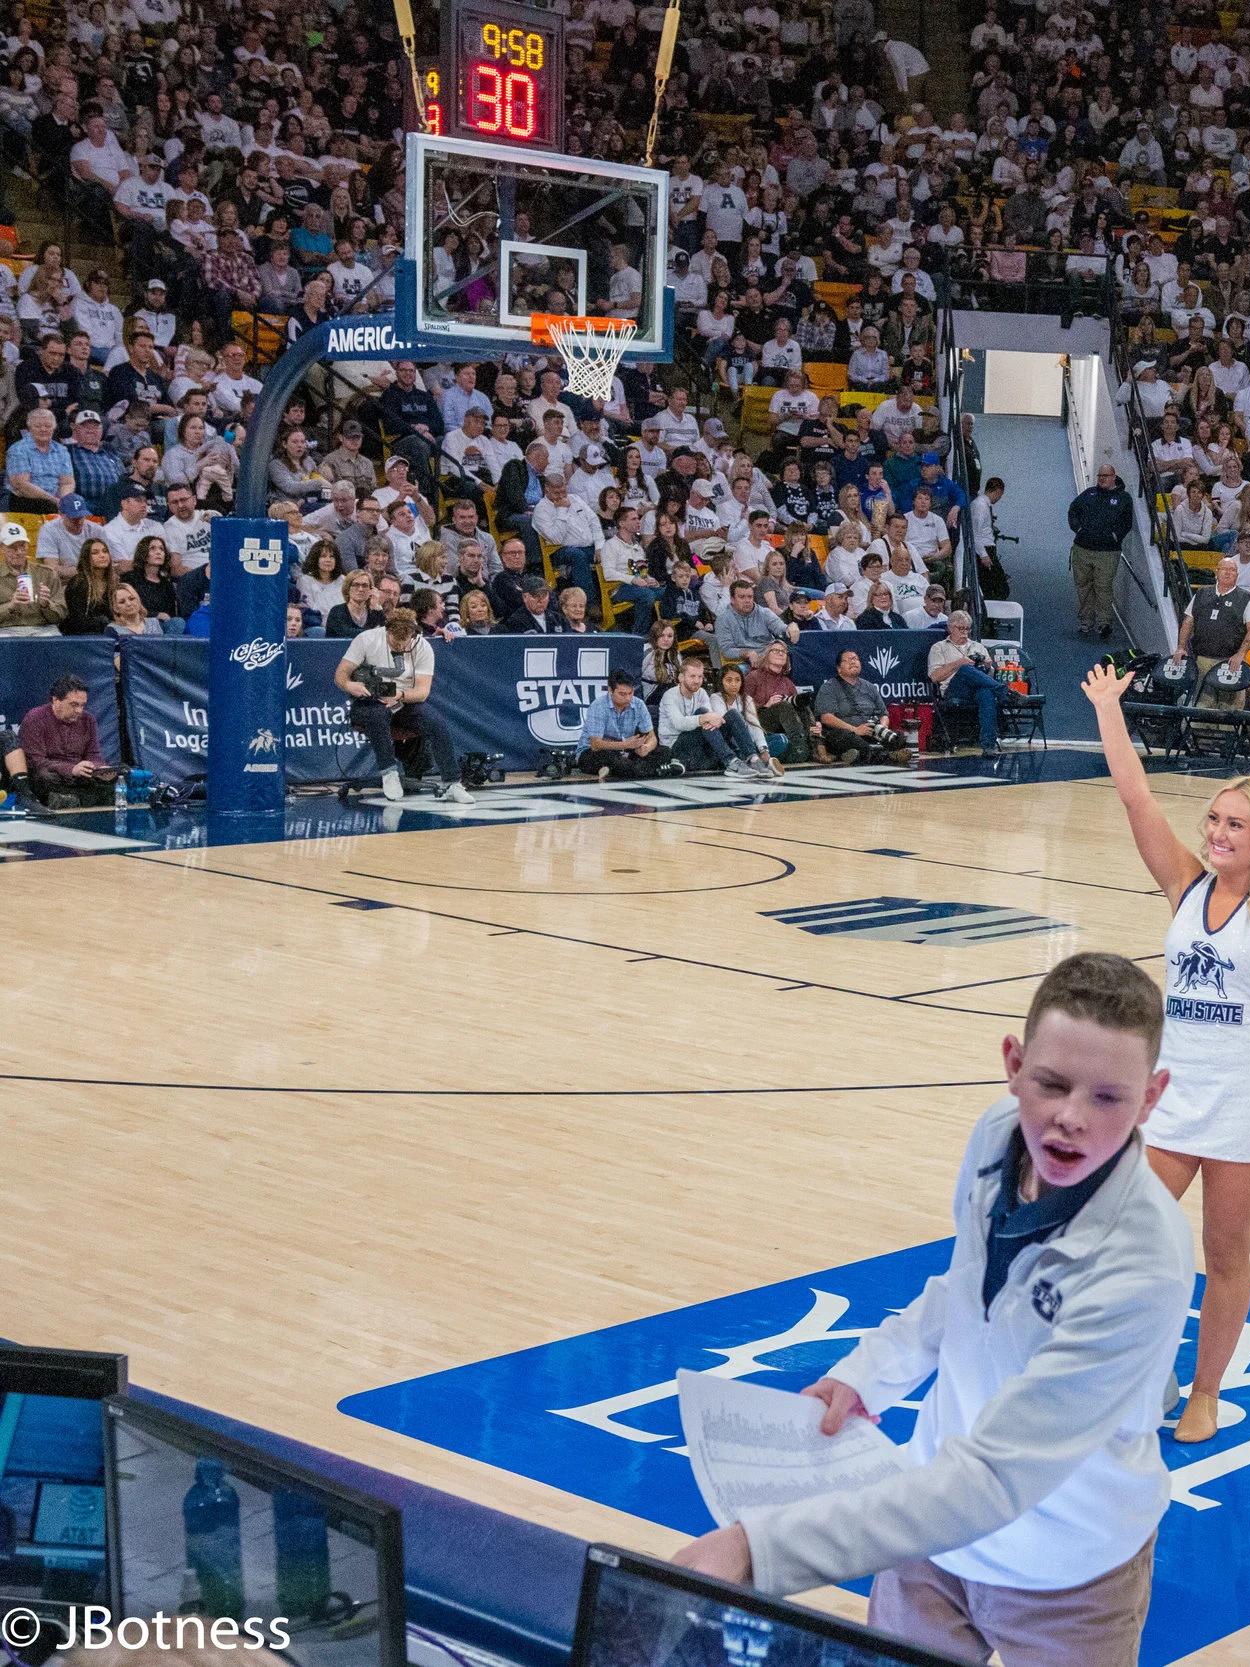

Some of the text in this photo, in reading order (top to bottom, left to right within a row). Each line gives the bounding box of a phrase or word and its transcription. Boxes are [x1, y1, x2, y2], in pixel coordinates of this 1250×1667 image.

[483, 23, 544, 70] 9:58
[474, 65, 535, 137] 30
[424, 323, 450, 332] SPALDING
[73, 500, 80, 509] P
[239, 548, 283, 563] STATE
[164, 731, 208, 753] Loga
[318, 730, 371, 749] Hosp
[1166, 996, 1243, 1024] UTAH STATE
[60, 1527, 98, 1542] AT&T
